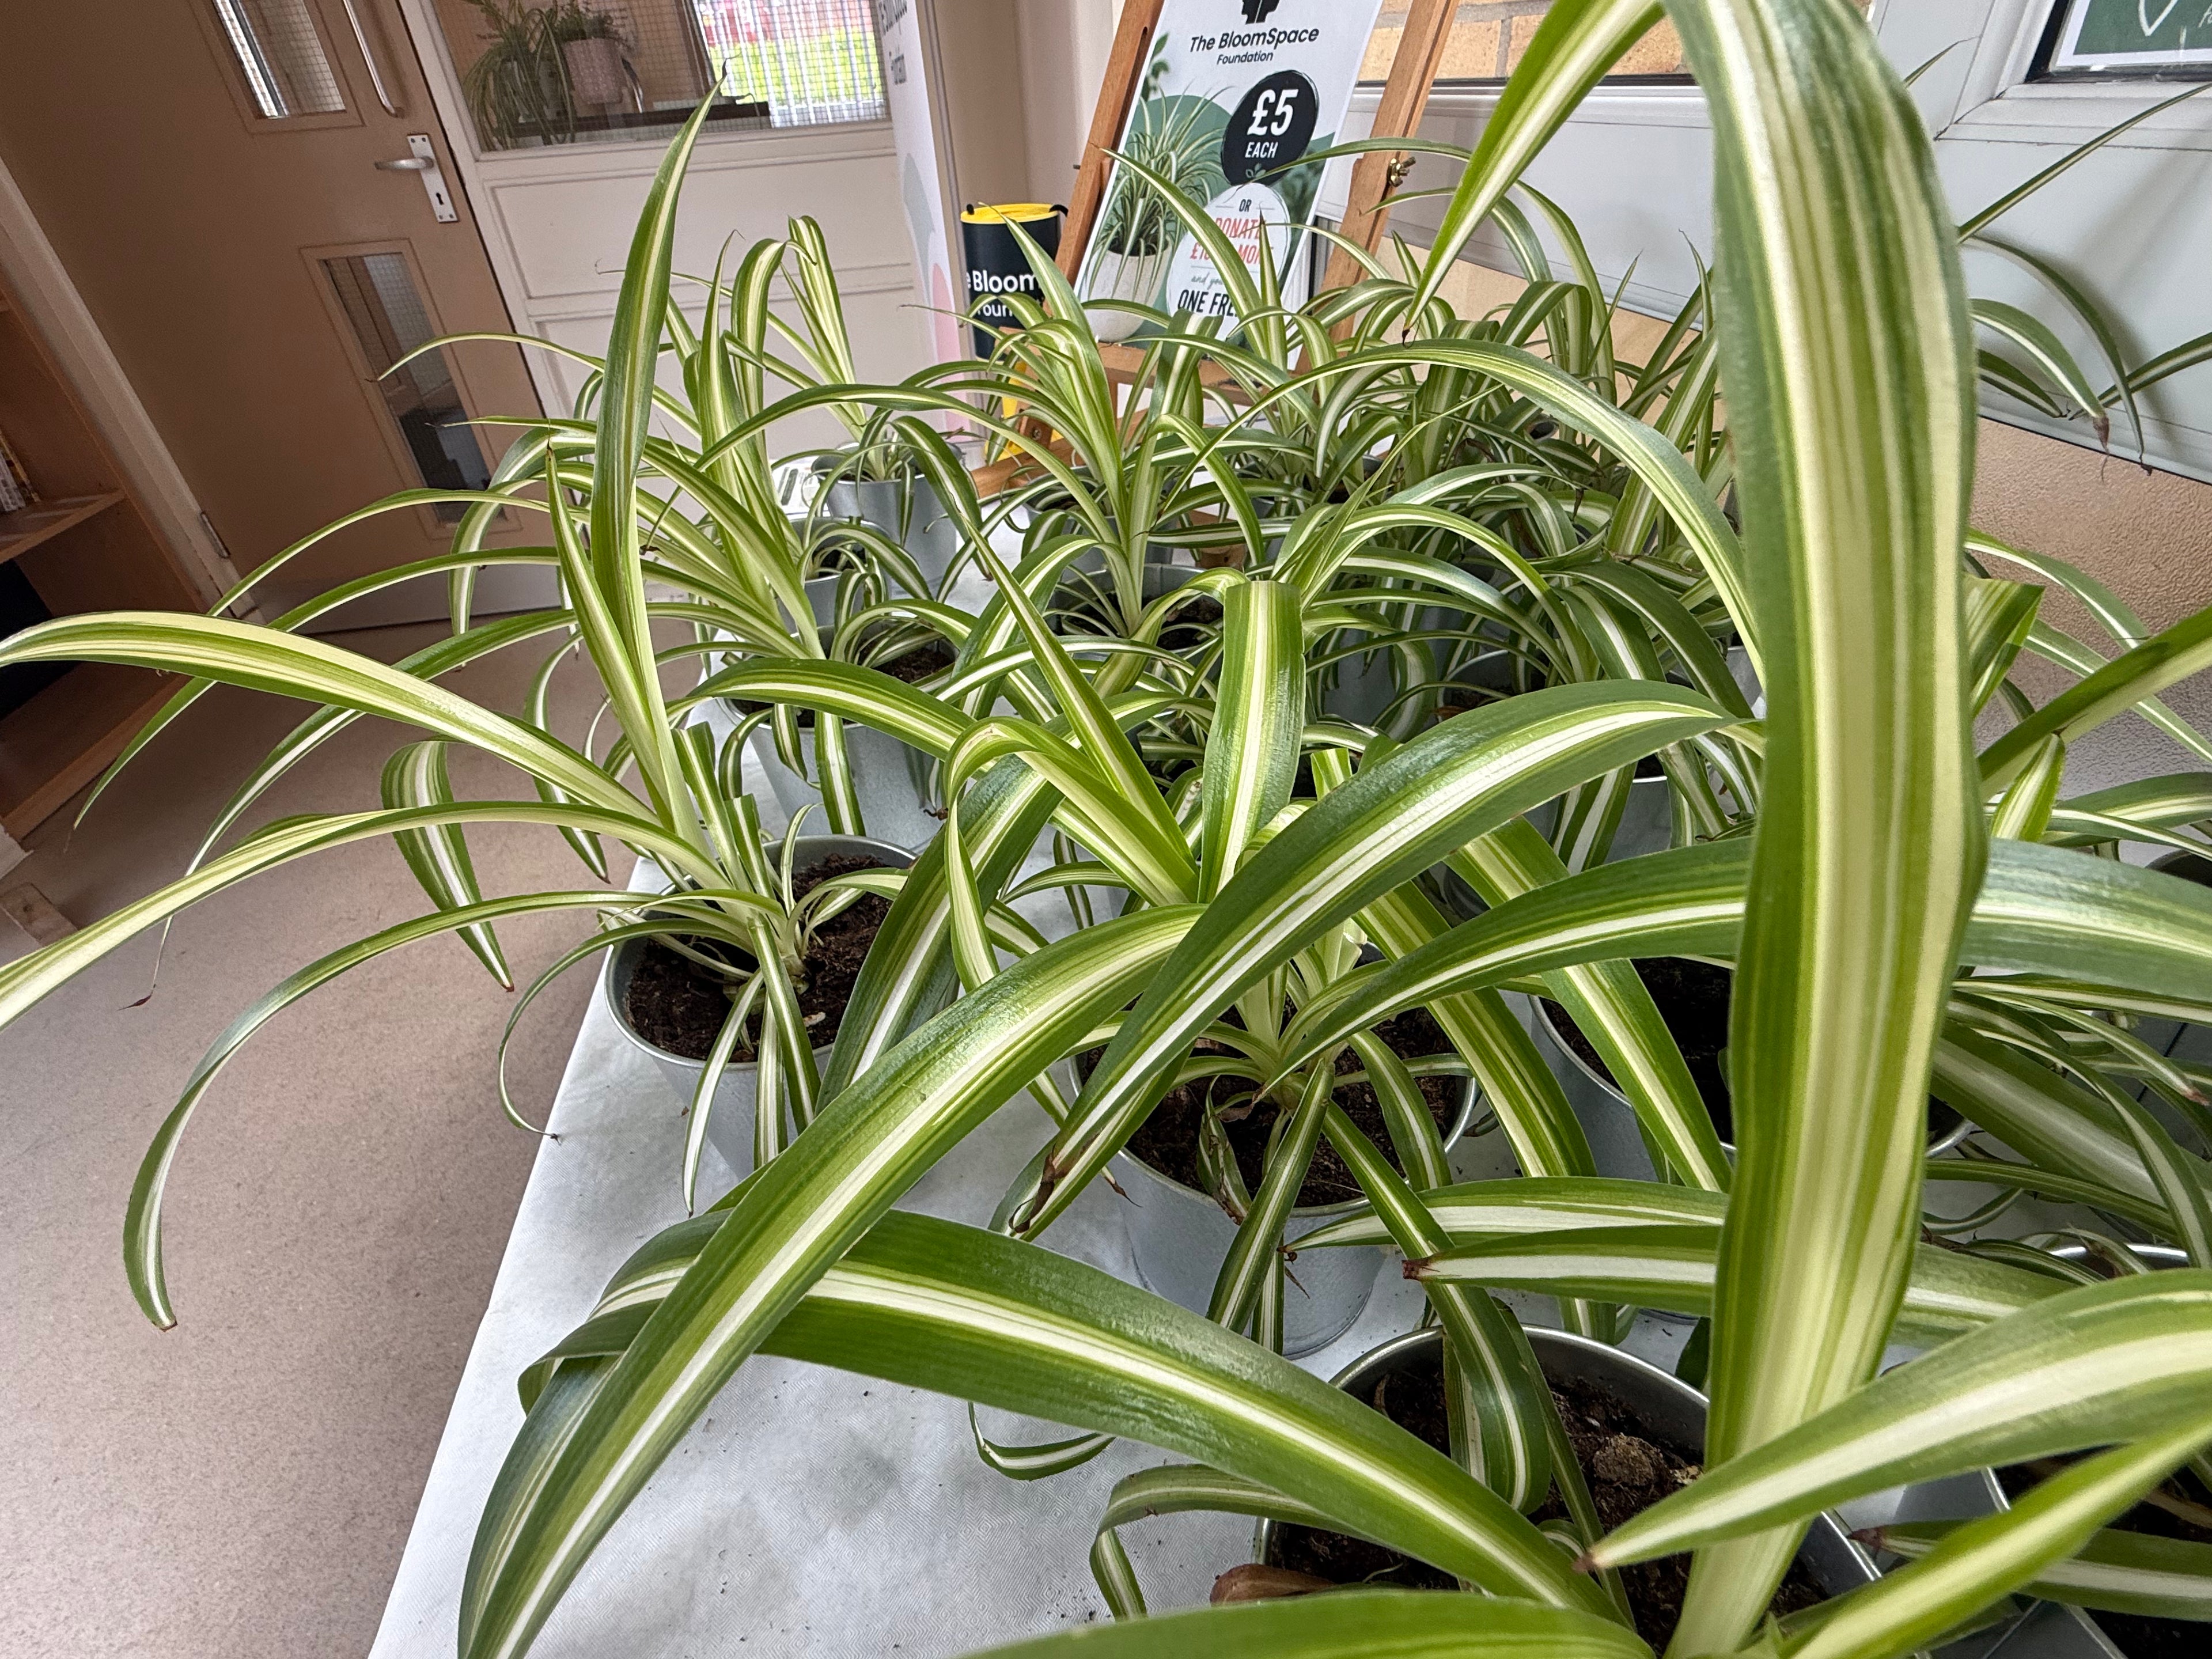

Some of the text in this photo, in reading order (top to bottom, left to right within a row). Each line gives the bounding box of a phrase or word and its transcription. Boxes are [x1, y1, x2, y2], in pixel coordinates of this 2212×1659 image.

[1190, 28, 1319, 52] The BloomSpace
[1217, 50, 1274, 65] Foundation
[1247, 89, 1298, 136] £5
[1245, 142, 1278, 158] EACH
[1239, 199, 1252, 212] OR
[1191, 272, 1210, 285] and
[1177, 289, 1238, 317] ONE FRE
